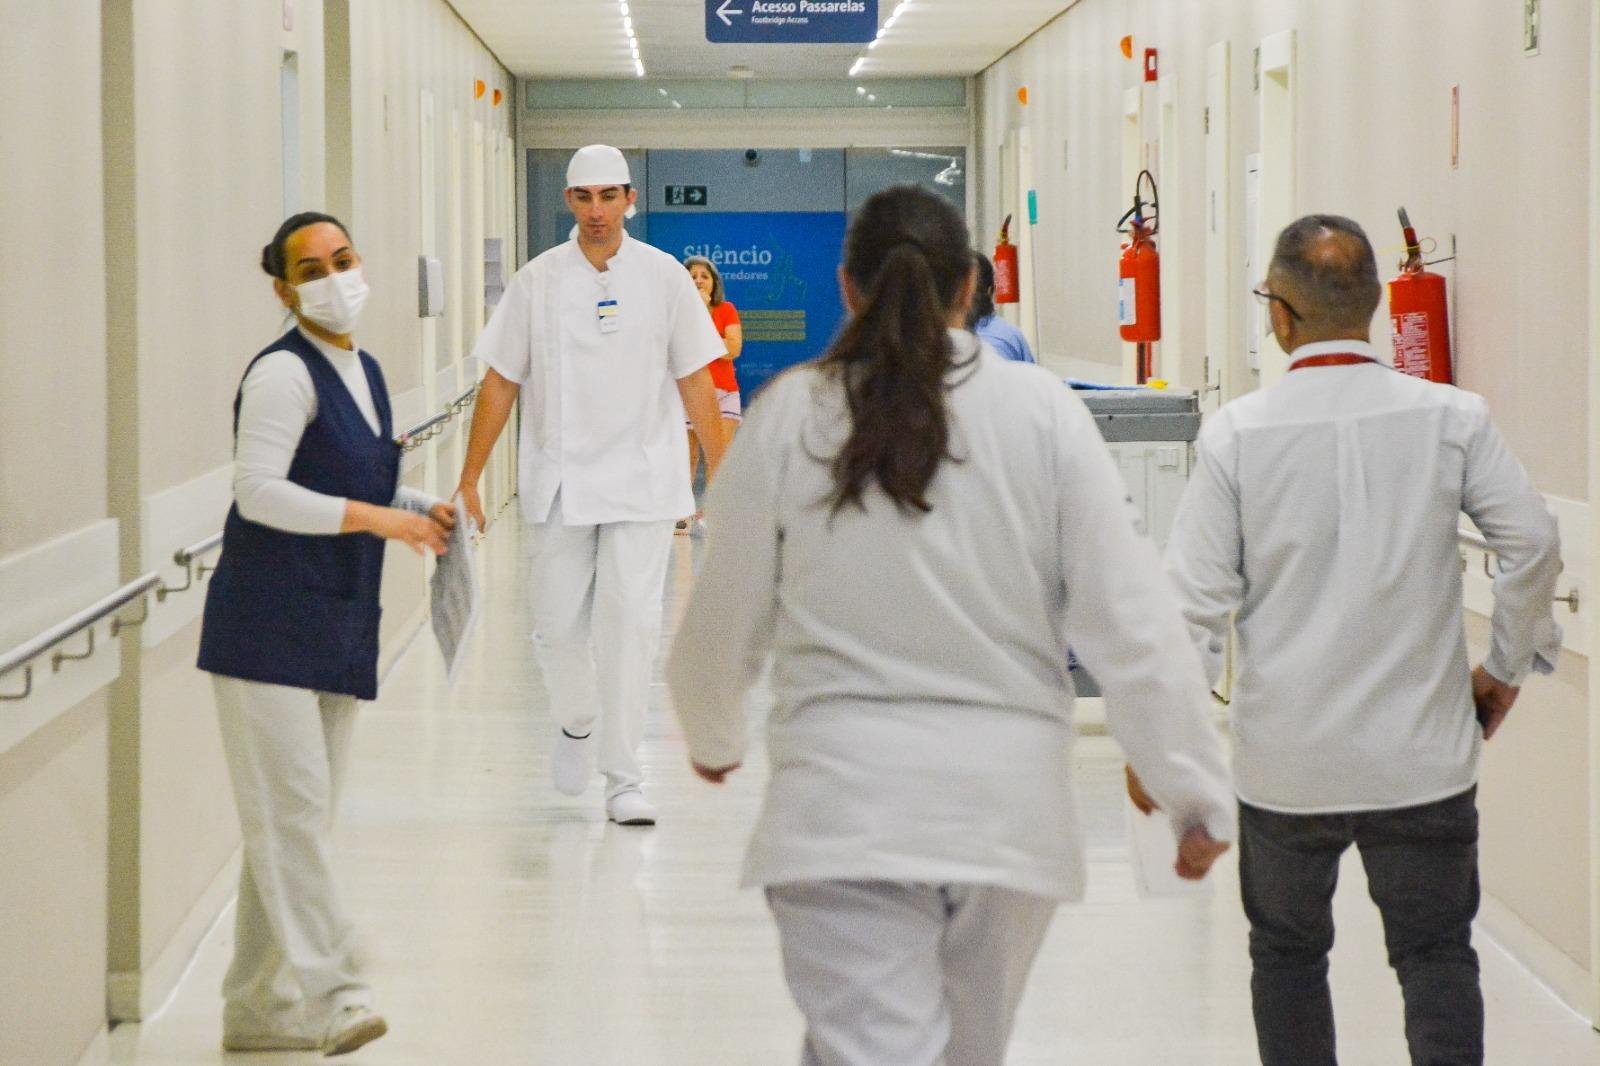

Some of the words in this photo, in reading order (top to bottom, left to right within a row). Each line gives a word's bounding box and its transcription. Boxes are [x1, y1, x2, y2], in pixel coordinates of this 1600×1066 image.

[751, 1, 796, 13] Acesso
[800, 0, 866, 13] Passarelas
[751, 16, 786, 25] Footbridge
[787, 16, 809, 24] Access
[720, 269, 769, 280] rredores
